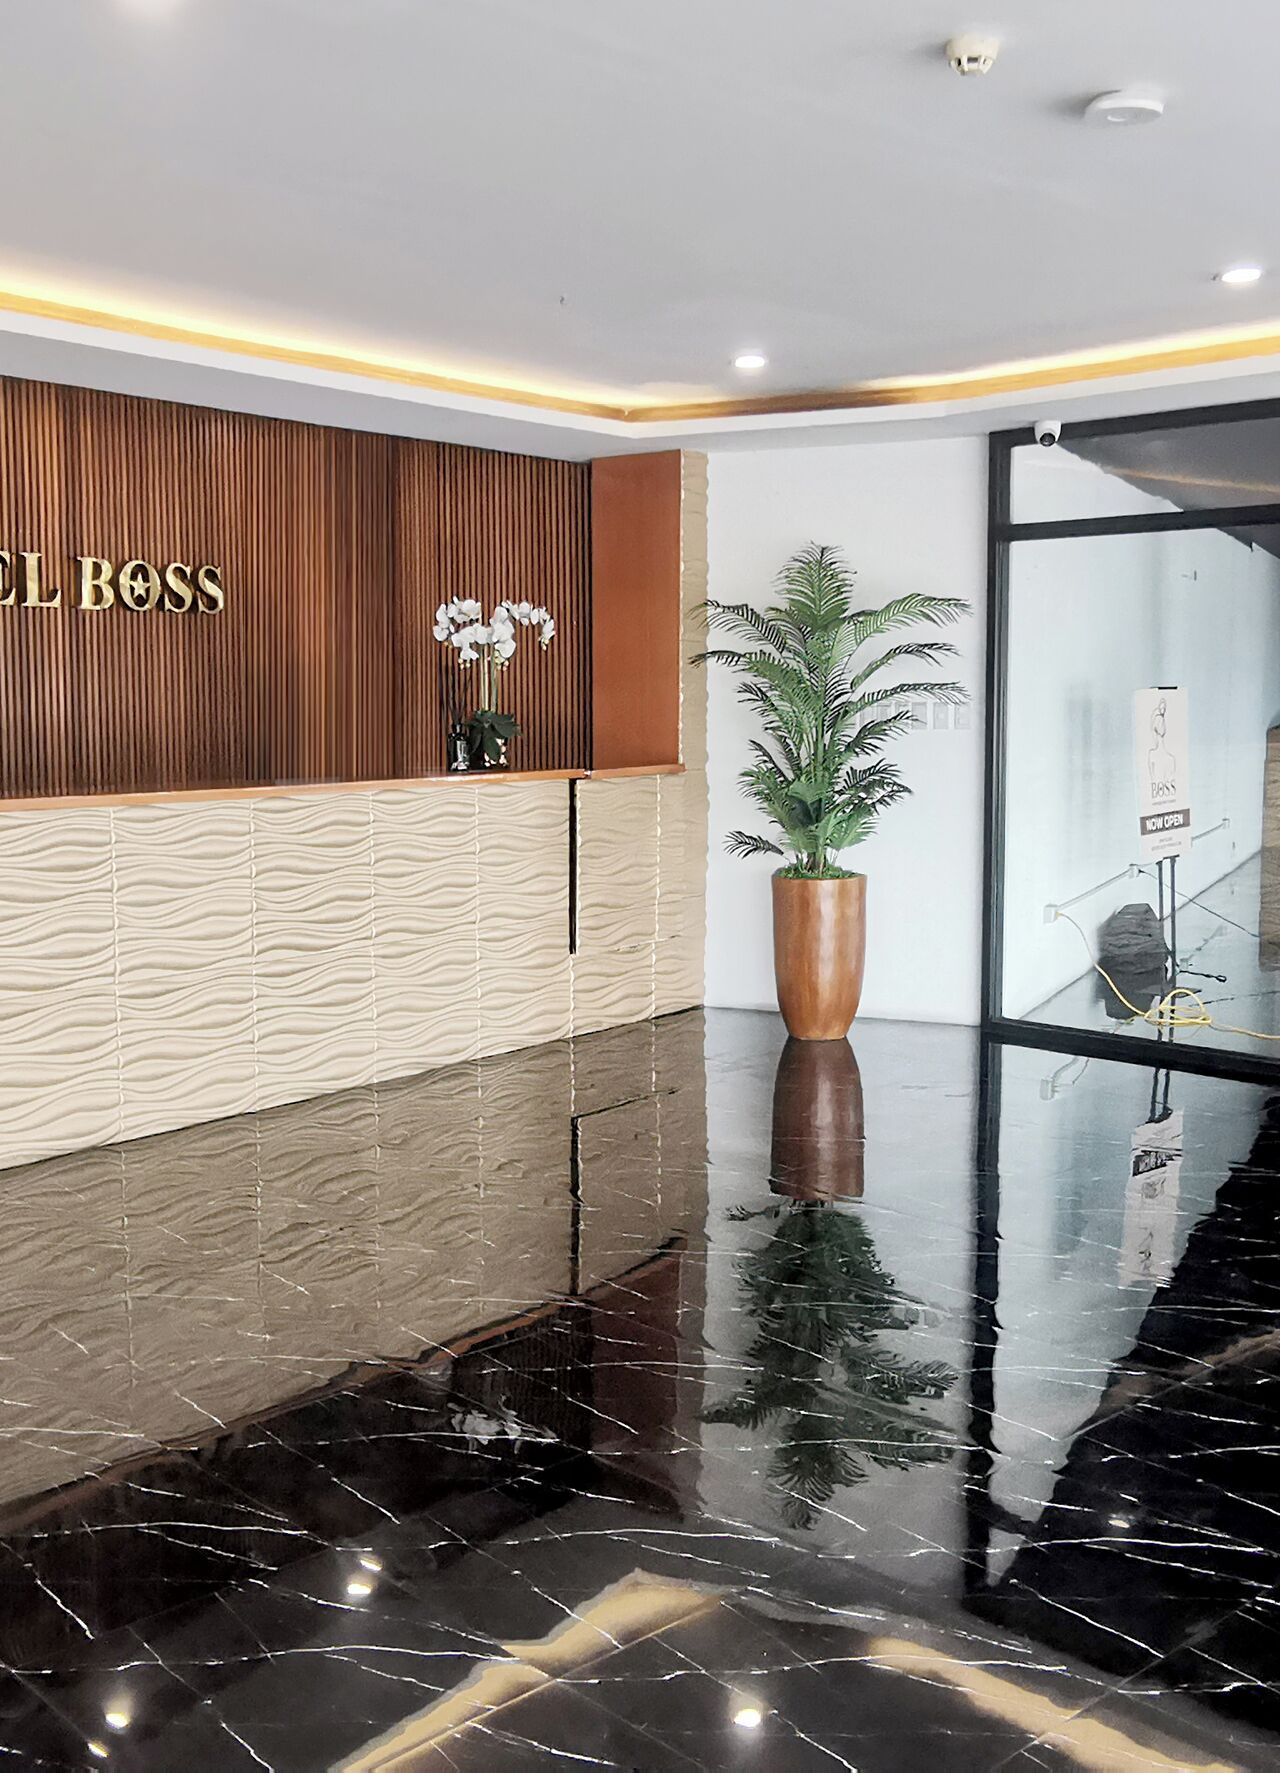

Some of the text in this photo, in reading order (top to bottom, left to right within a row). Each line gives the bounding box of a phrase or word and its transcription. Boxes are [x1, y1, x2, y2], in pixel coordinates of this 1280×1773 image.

[77, 556, 223, 614] BOSS
[1151, 780, 1177, 798] BOSS
[1146, 814, 1183, 831] NOW OPEN
